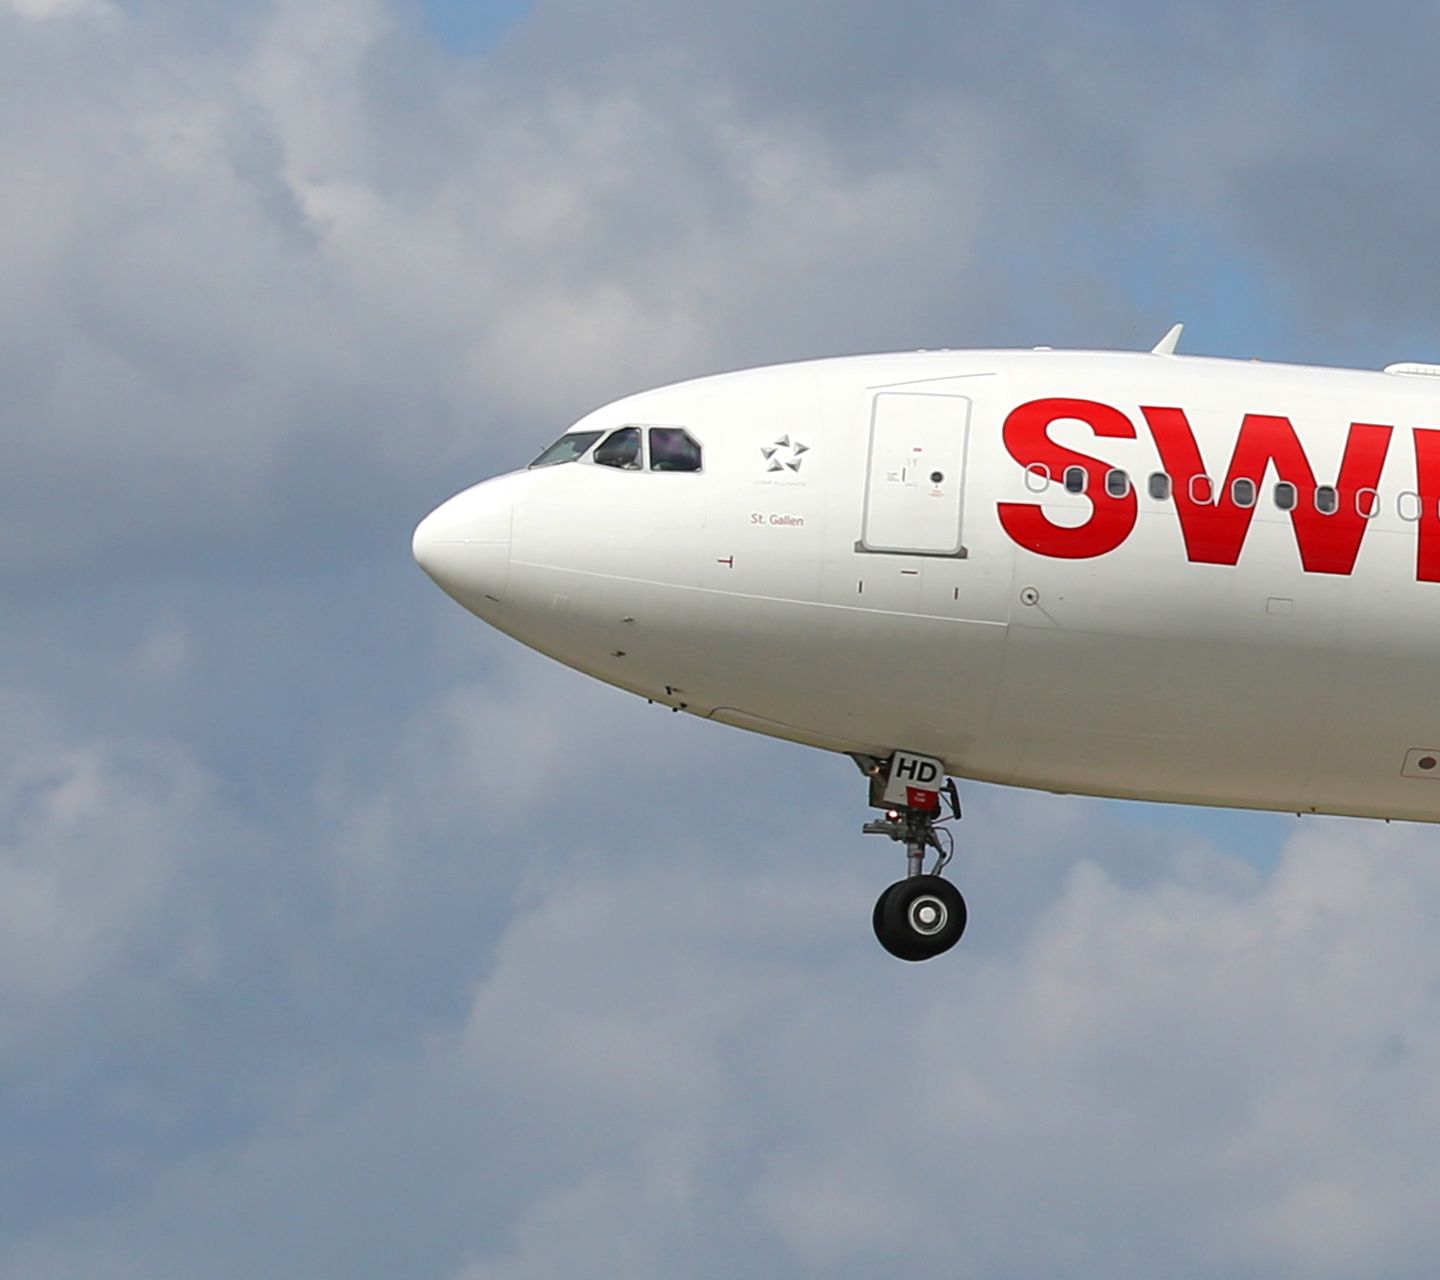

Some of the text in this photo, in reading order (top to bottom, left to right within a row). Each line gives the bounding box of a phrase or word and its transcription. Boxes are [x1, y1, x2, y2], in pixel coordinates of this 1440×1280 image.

[750, 512, 804, 526] St. Gallen
[896, 757, 938, 783] HD
